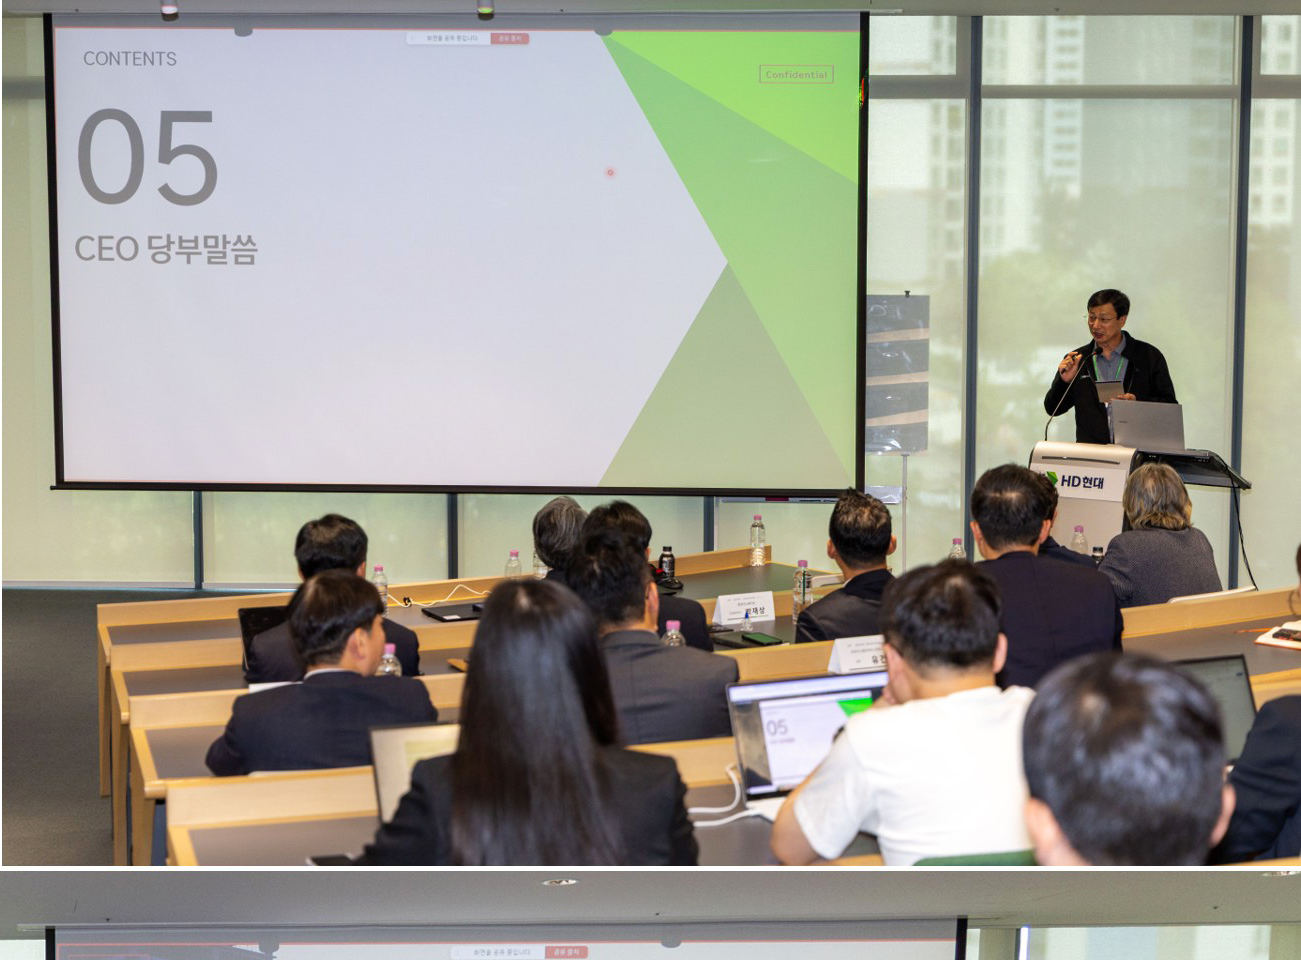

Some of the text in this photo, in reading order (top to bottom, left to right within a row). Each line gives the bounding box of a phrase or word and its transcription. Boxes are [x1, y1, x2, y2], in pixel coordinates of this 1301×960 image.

[84, 51, 176, 66] CONTENTS
[765, 70, 828, 79] Confidential
[78, 108, 217, 206] 05
[75, 234, 258, 265] CEO 당부말씀
[1061, 475, 1104, 489] HD현대
[766, 719, 788, 735] 05
